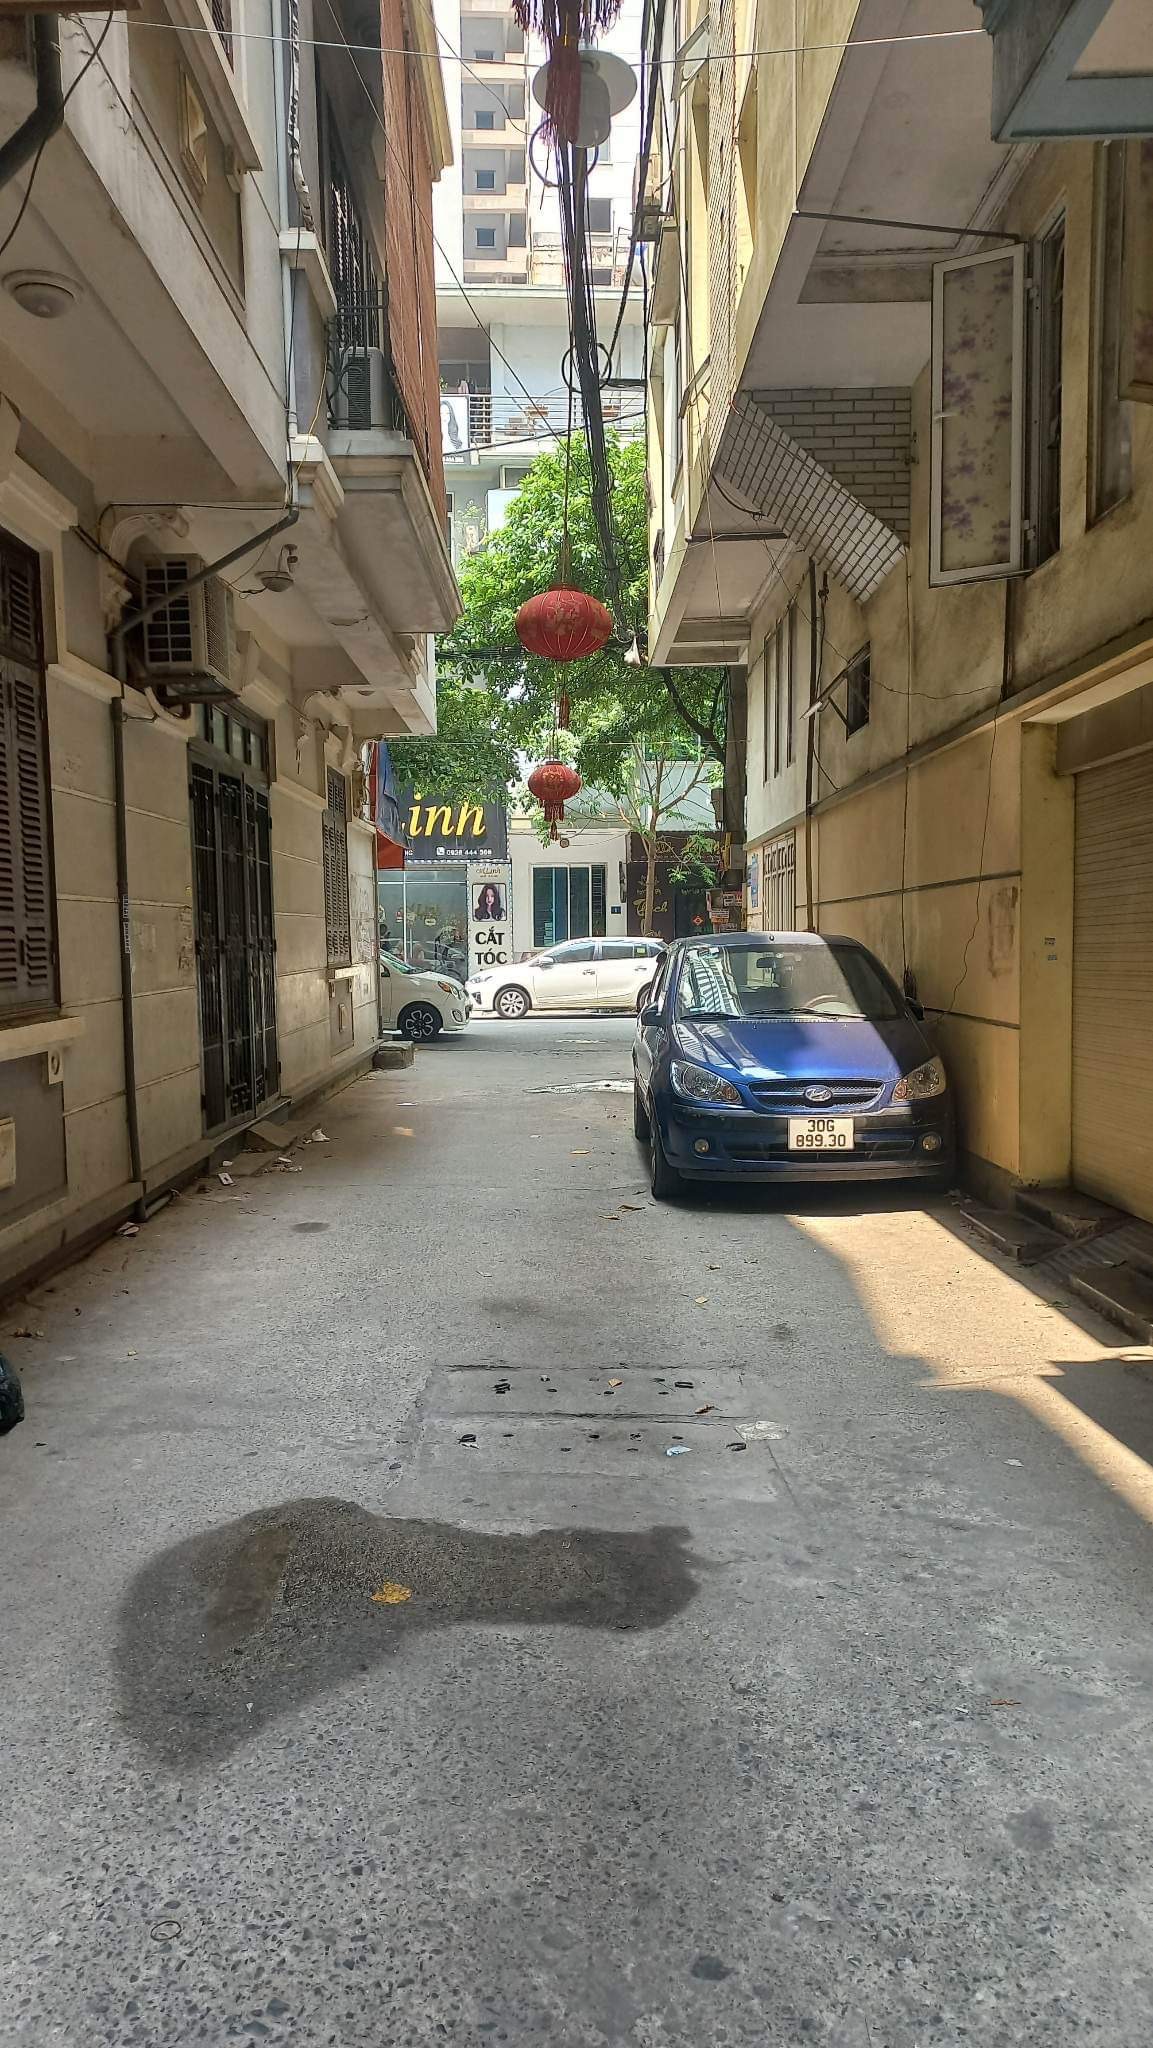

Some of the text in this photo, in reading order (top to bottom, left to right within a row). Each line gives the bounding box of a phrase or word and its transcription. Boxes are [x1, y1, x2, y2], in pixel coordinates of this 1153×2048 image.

[402, 792, 486, 836] inh
[475, 926, 505, 945] CẮT
[475, 948, 508, 965] TÓC
[808, 1119, 835, 1132] 30G
[796, 1134, 846, 1147] 899.30
